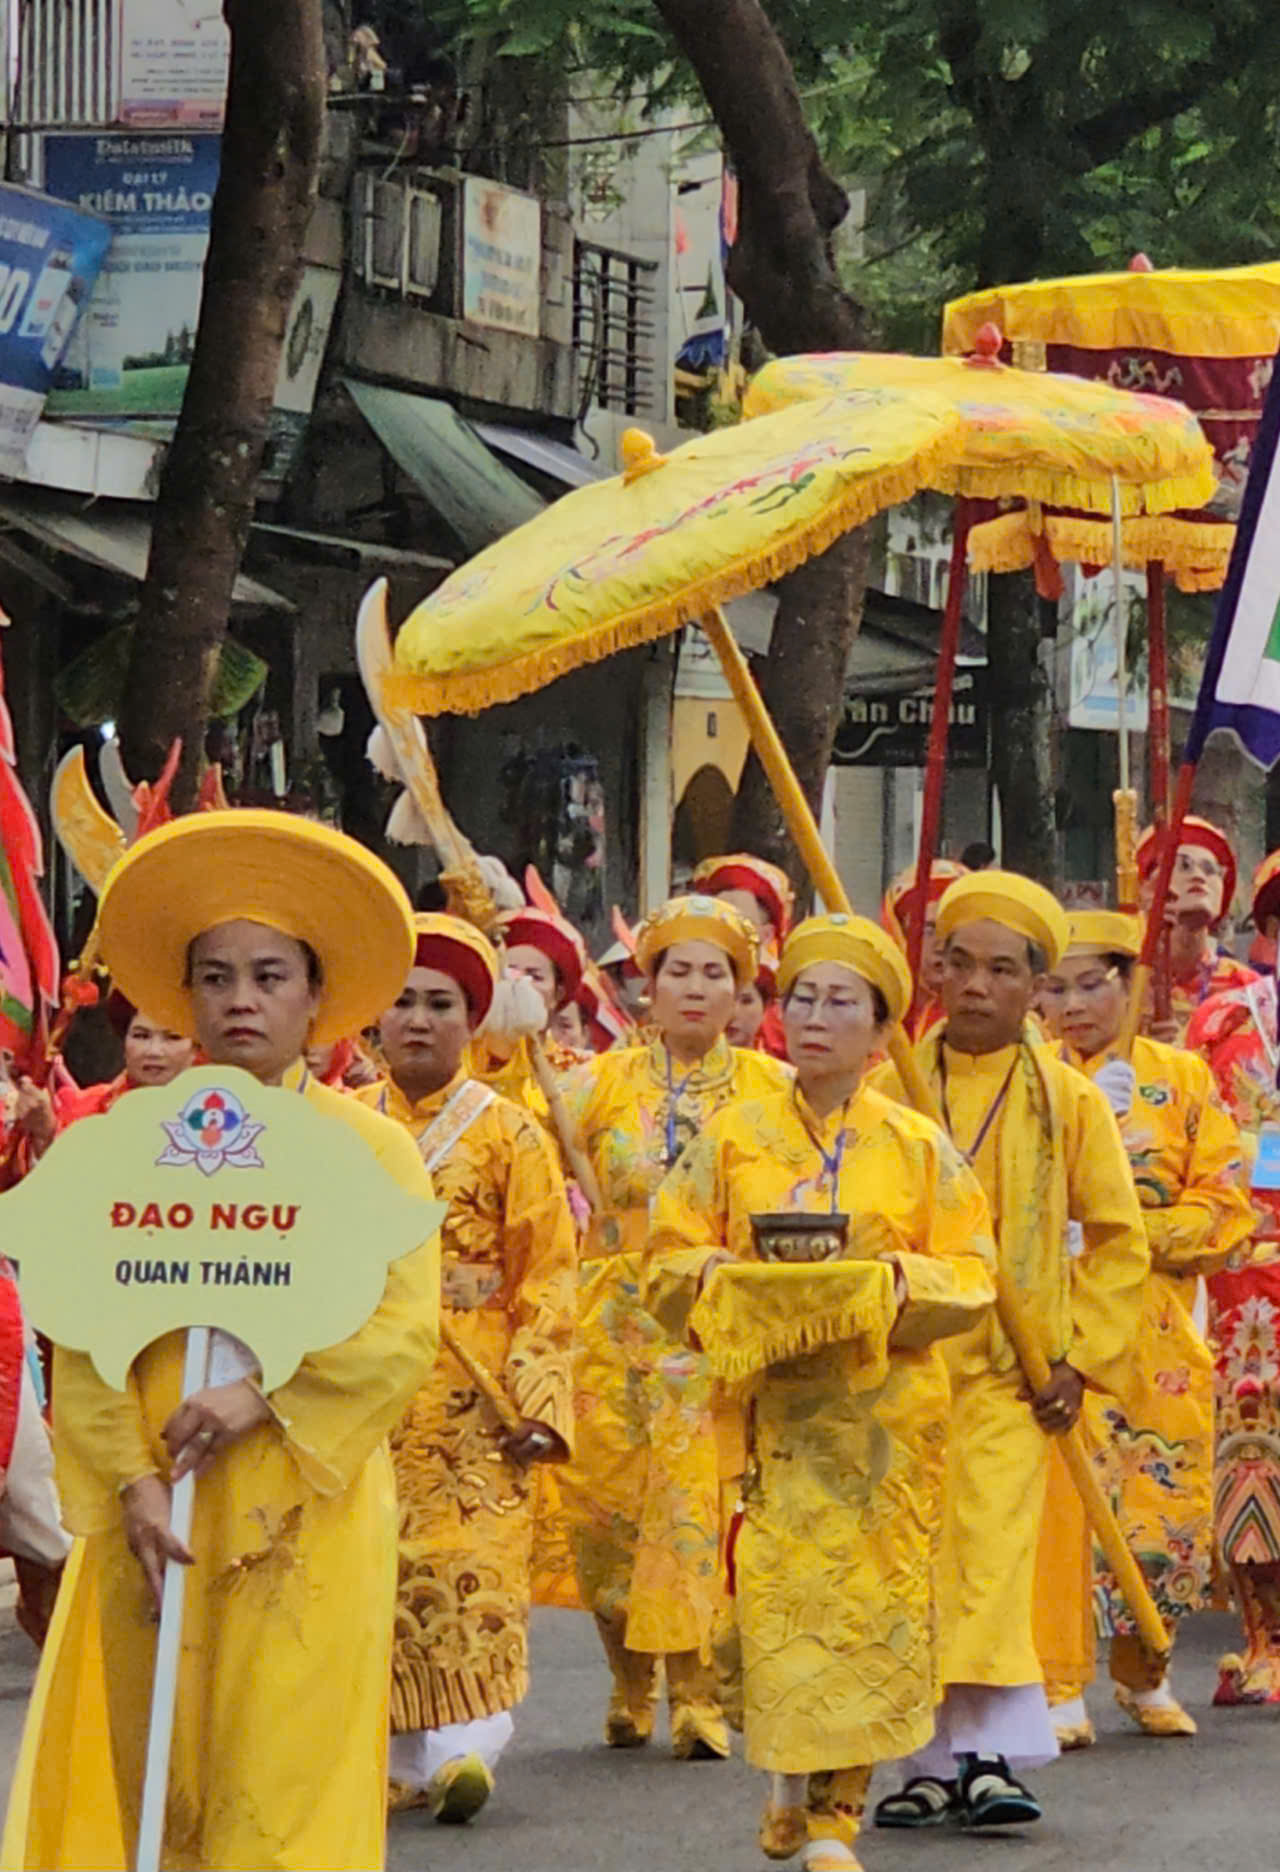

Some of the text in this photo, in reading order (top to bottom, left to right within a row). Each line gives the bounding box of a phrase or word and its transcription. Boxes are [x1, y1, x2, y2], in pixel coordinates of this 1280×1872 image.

[110, 1202, 301, 1240] ĐẠO NGỰ
[115, 1259, 190, 1286] QUAN
